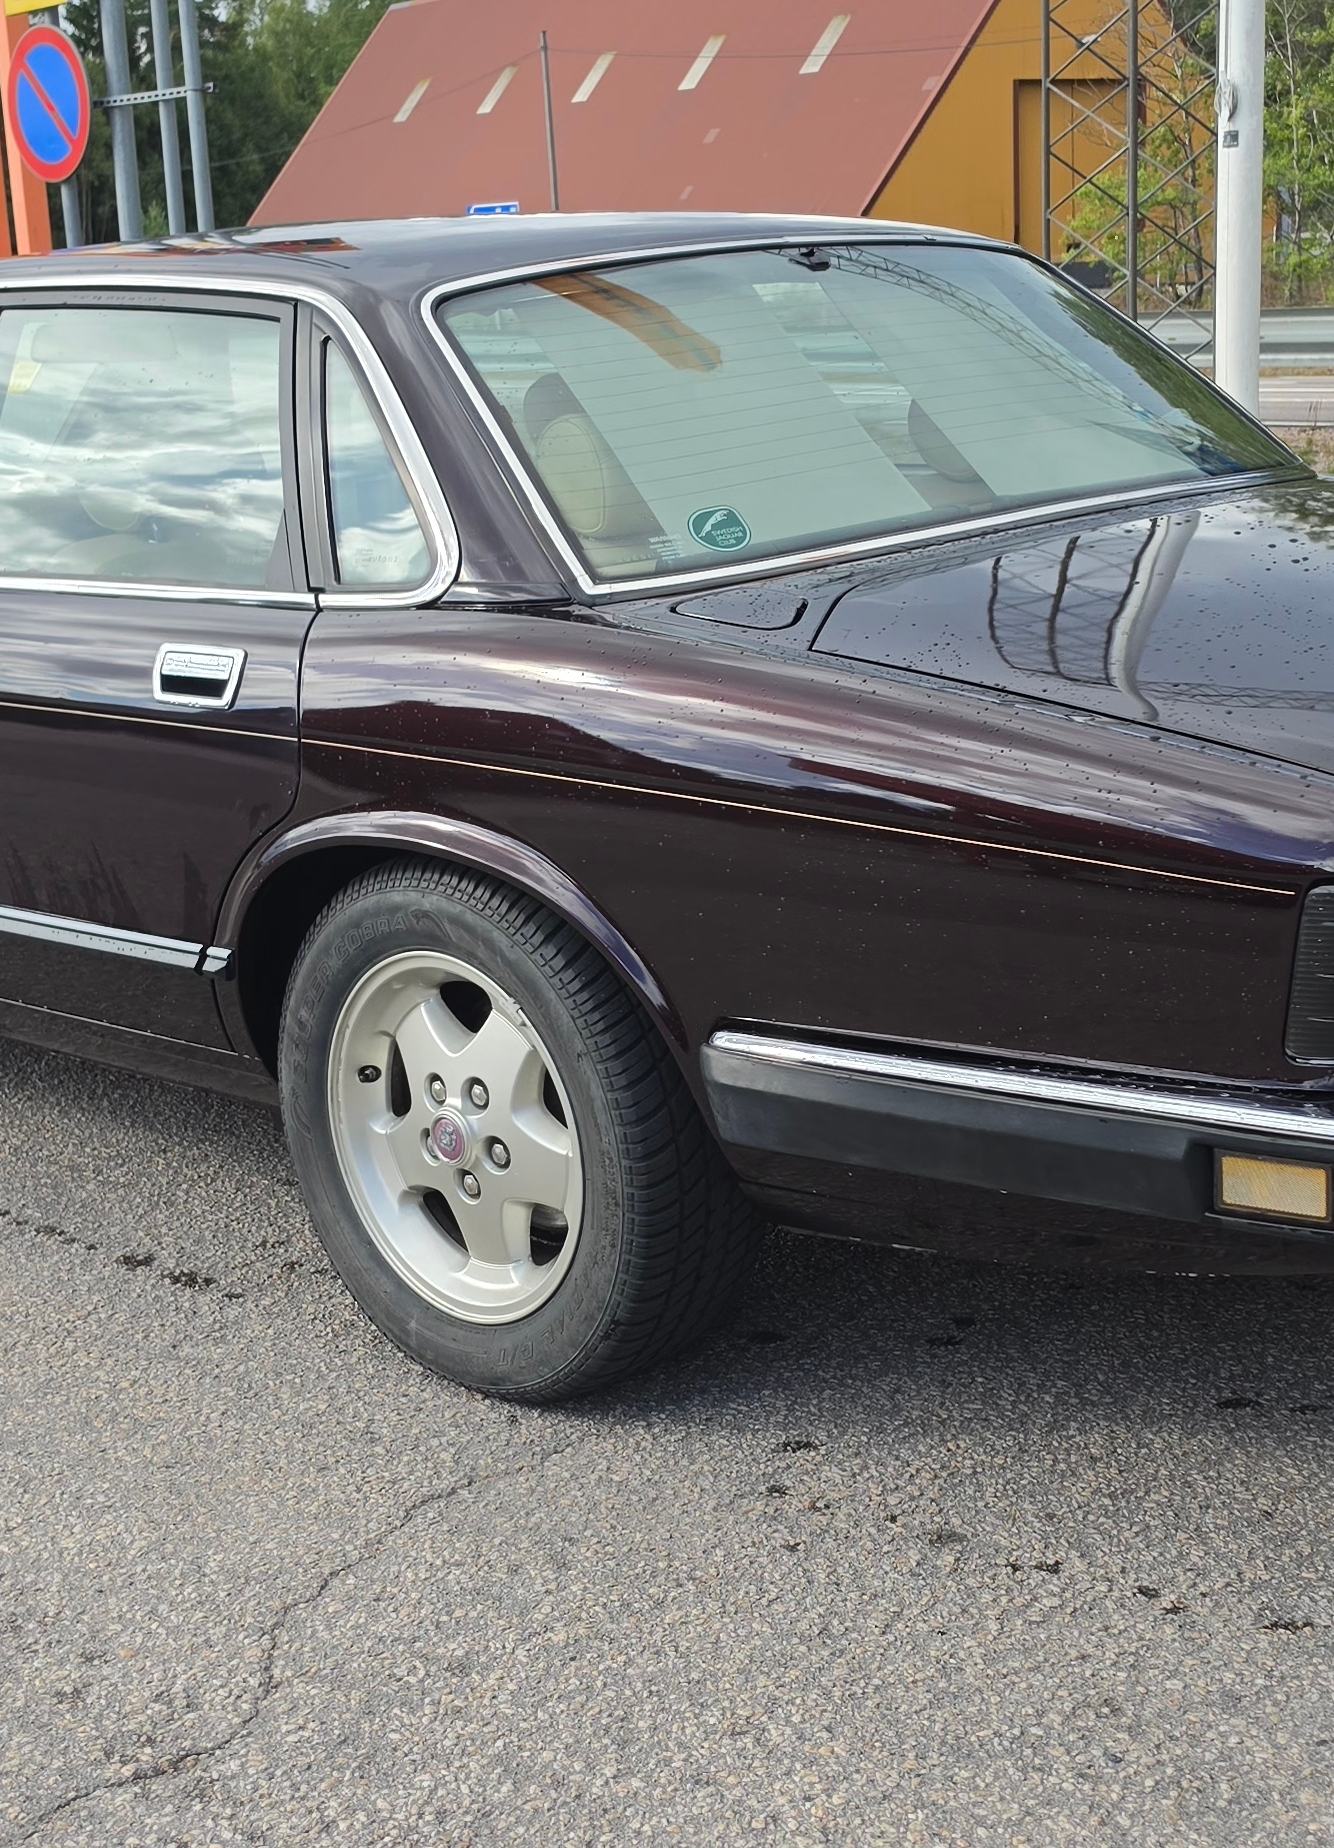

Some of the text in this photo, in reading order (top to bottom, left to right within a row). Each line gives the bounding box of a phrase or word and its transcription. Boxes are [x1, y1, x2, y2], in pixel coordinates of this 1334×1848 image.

[712, 526, 744, 537] SWEDISH
[716, 531, 744, 541] JAGUAR
[718, 538, 737, 546] CLUB
[293, 915, 407, 1083] SUPER COBRA
